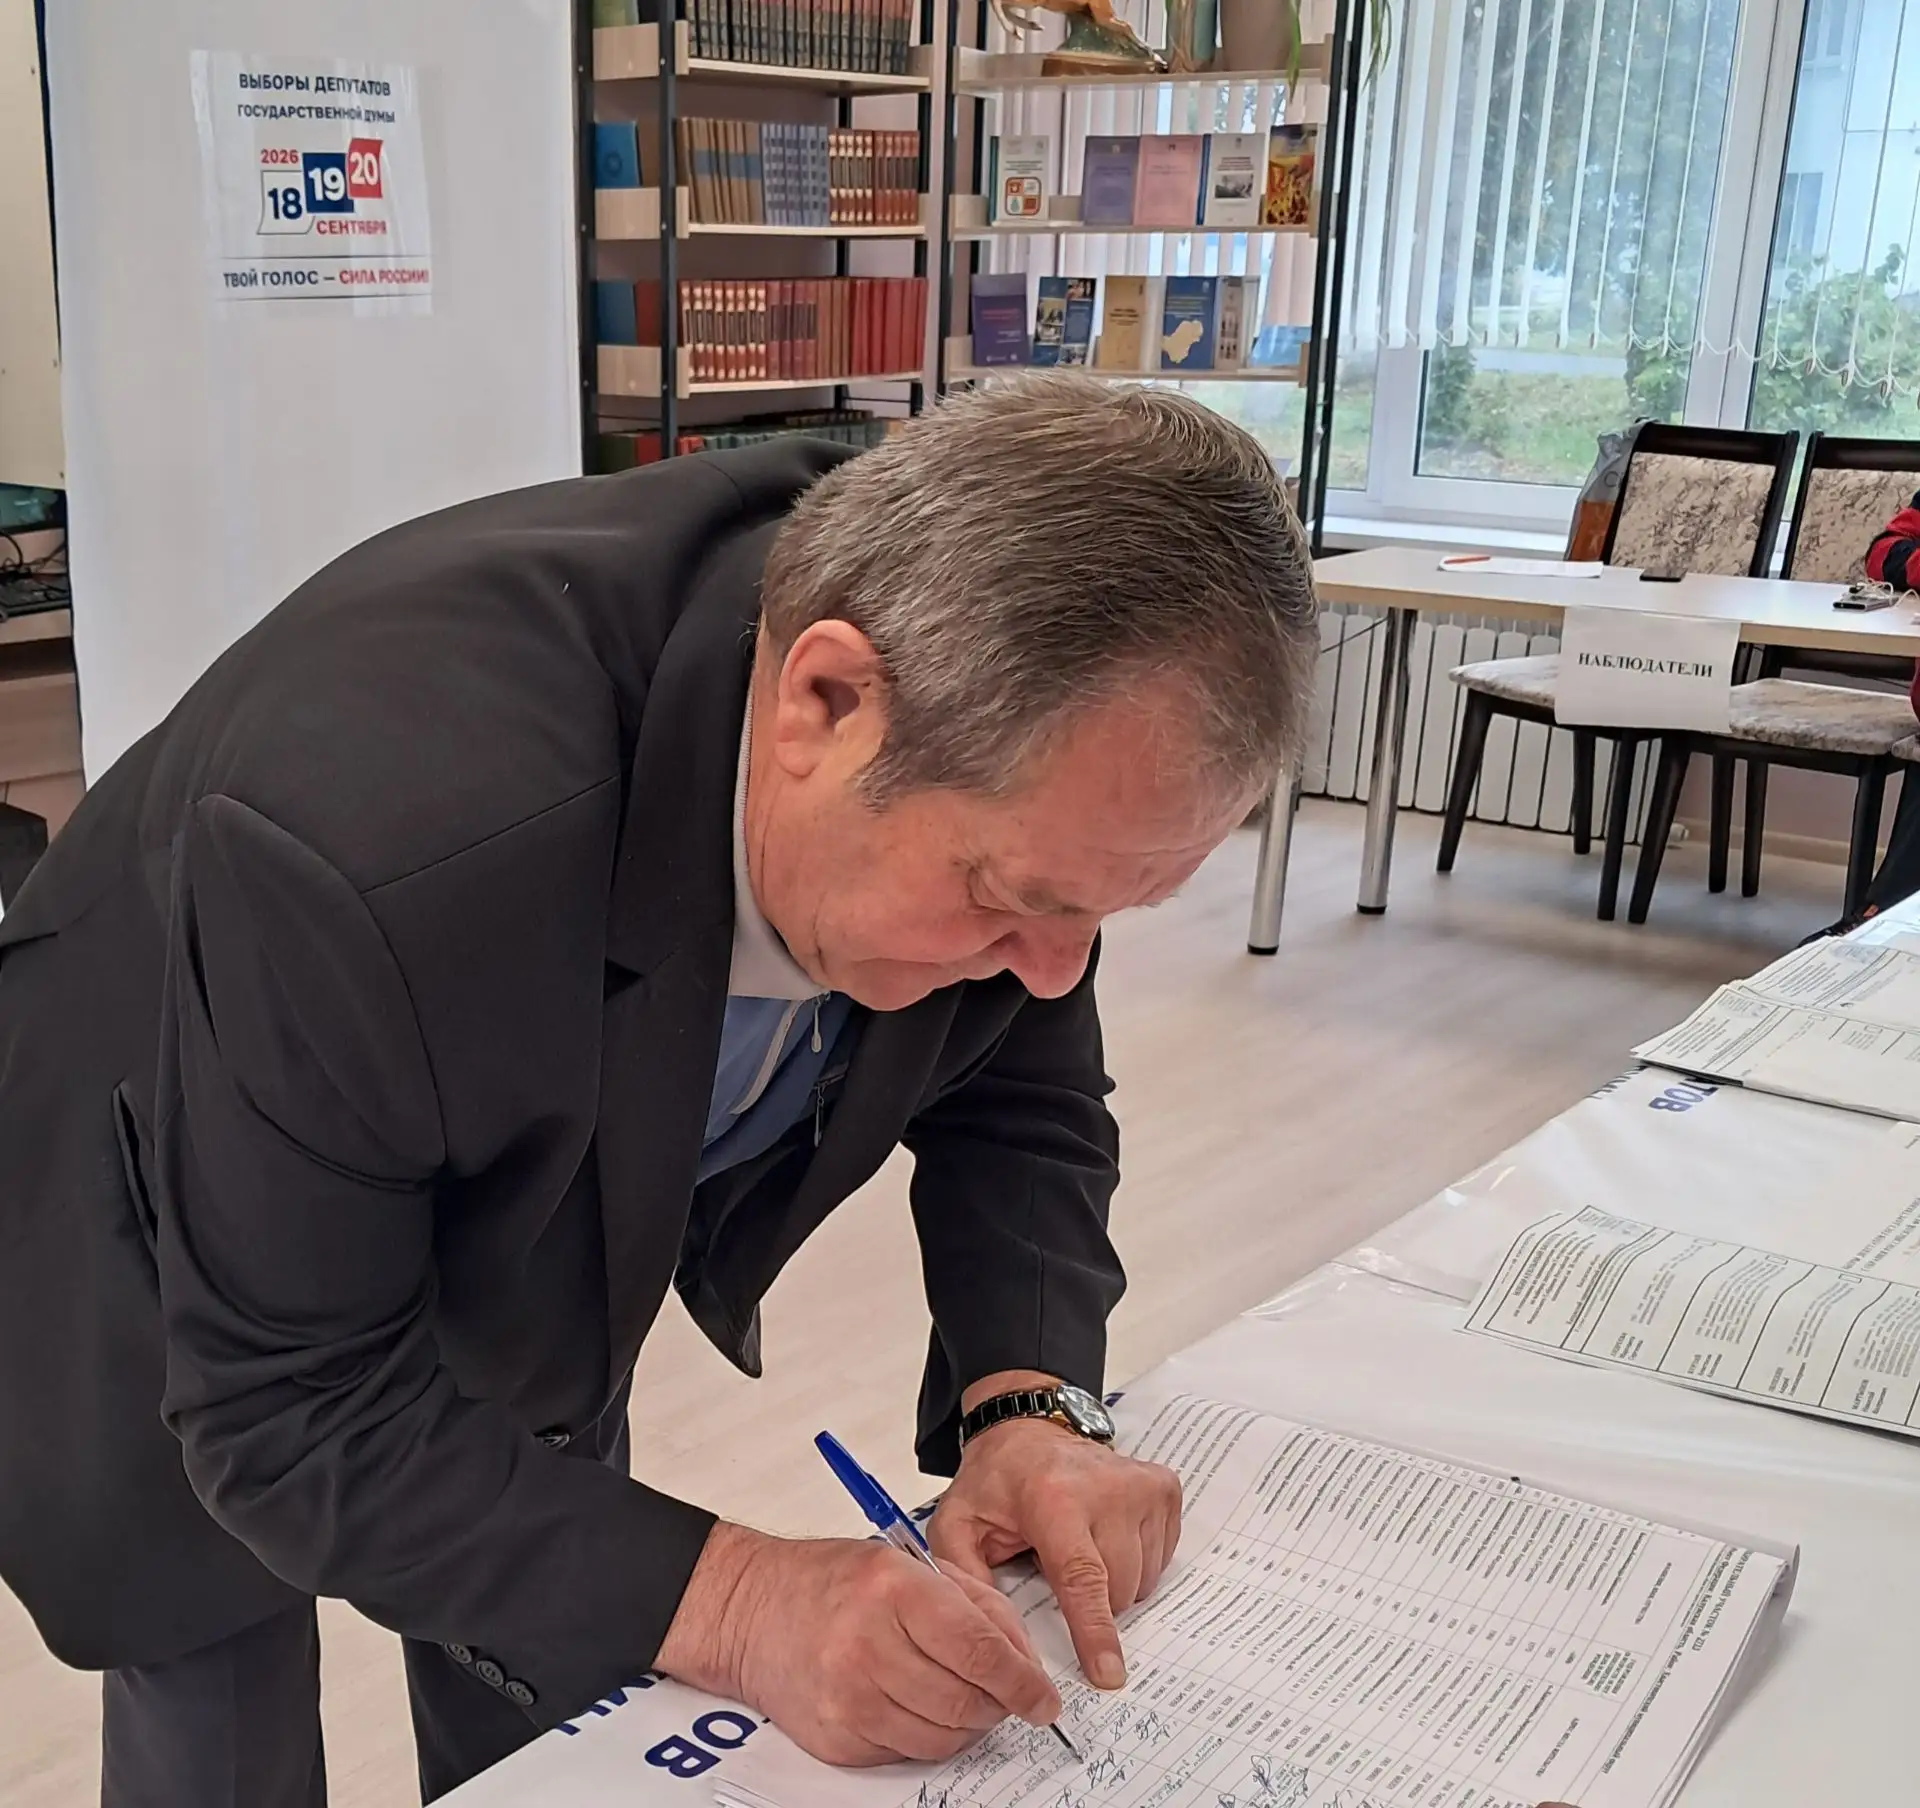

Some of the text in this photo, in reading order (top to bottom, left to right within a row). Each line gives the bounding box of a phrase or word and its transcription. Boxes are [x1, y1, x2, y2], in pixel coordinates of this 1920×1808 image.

[239, 73, 391, 97] ВЫБОРЫ ДЕПУТАТОВ
[237, 104, 395, 123] ГОСУДАРСТВЕННОЙ ДУМЫ
[261, 149, 299, 164] 2026
[268, 152, 379, 220] 18 19 20
[316, 220, 387, 235] СЕНТЯБРЯ
[223, 269, 259, 288] ТВОЙ
[261, 270, 319, 286] ГОЛОС
[339, 269, 376, 285] СИЛА
[379, 269, 429, 284] РОССИИ!
[1578, 652, 1713, 677] НАБЛЮДАТЕЛИ
[1648, 1078, 1725, 1112] ТОВ
